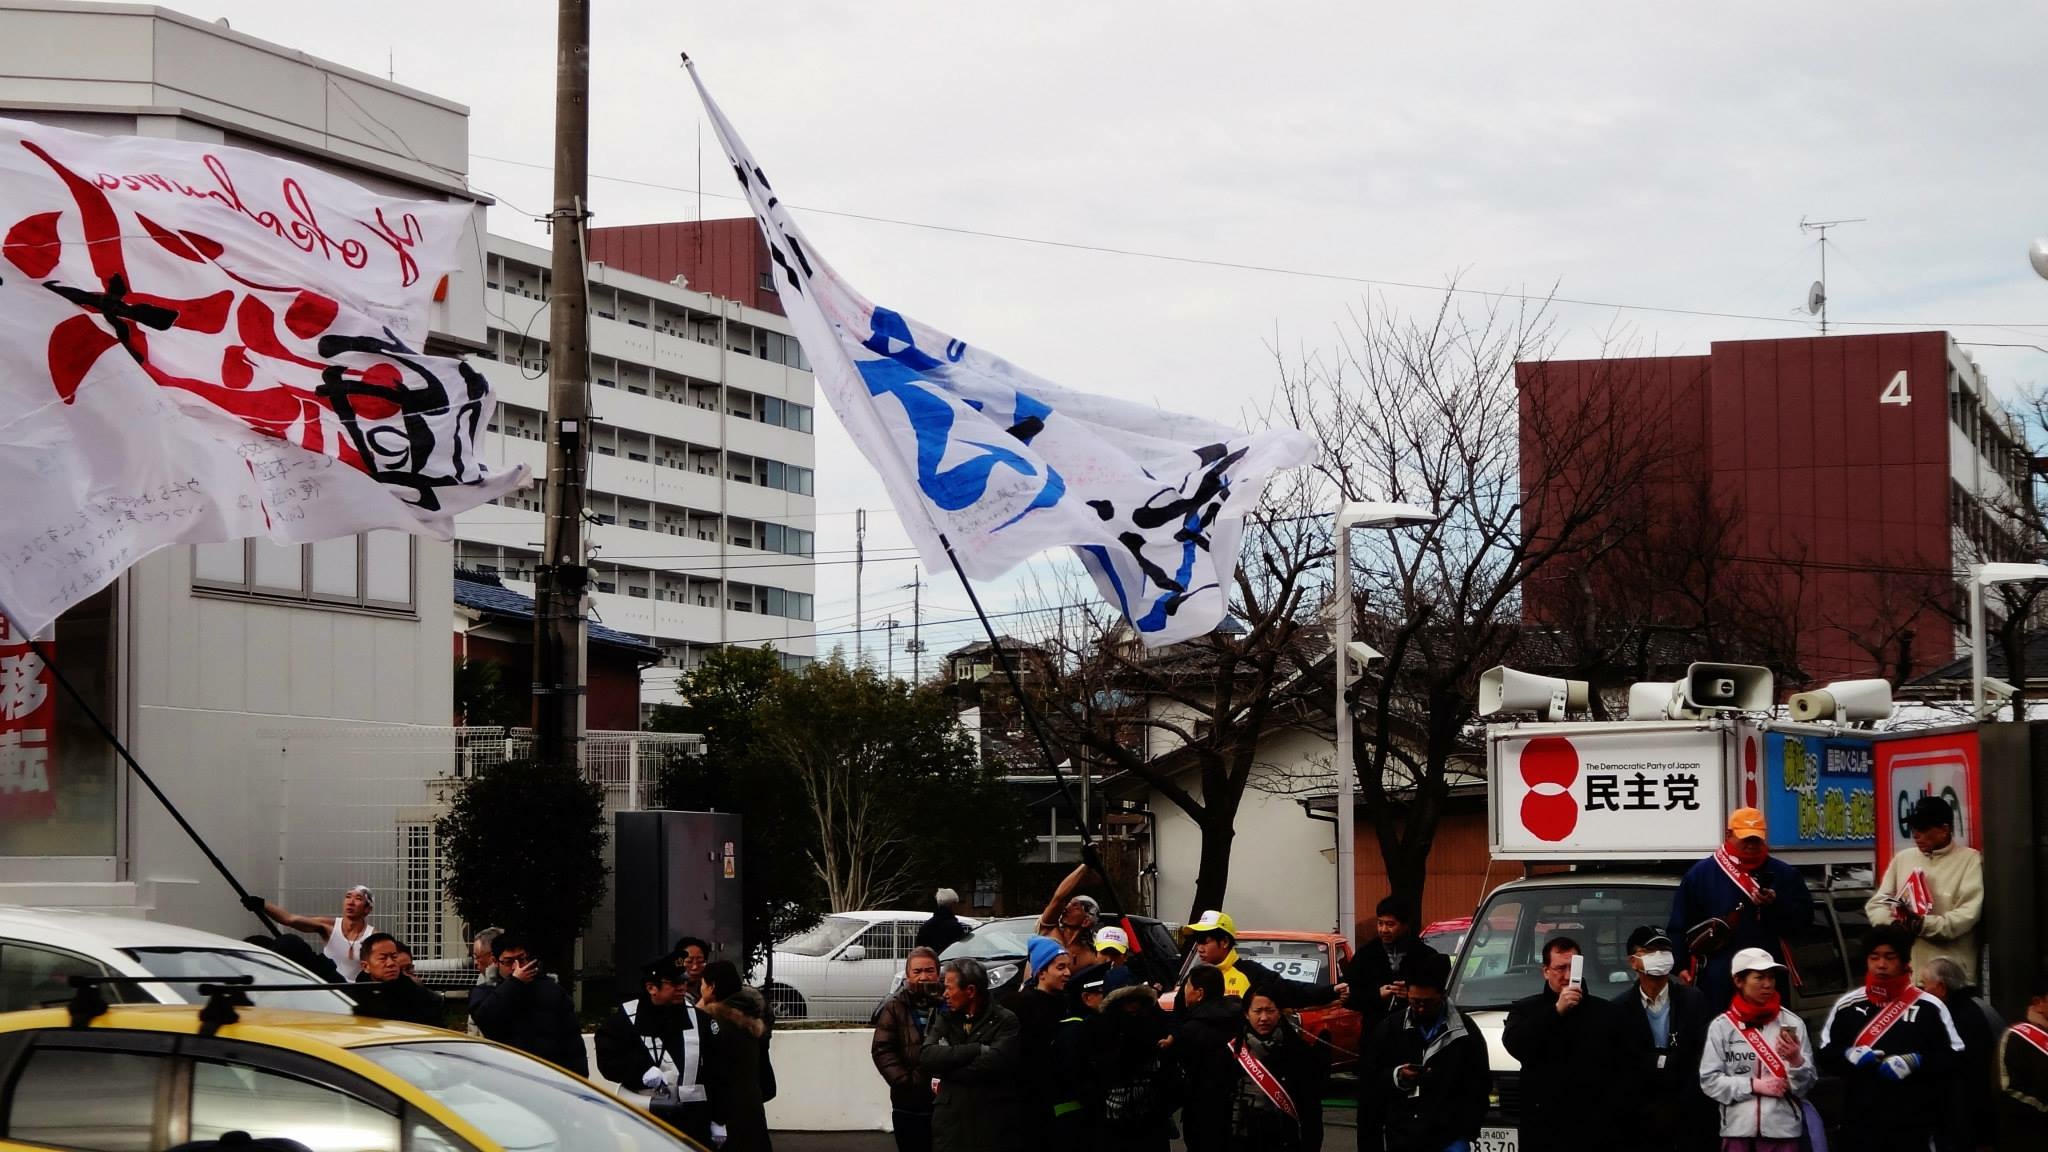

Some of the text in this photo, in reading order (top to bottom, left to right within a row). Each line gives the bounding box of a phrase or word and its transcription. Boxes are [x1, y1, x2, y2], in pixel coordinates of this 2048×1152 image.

[1879, 369, 1912, 407] 4
[0, 651, 49, 792] 移転
[1586, 761, 1700, 771] The Democratic Party of Japan
[1584, 771, 1700, 811] 民主党
[1272, 961, 1303, 976] 95
[1879, 1000, 1907, 1028] TOYOTA
[1244, 1054, 1265, 1081] TOYOTA
[1724, 1050, 1757, 1062] Move
[1756, 1040, 1781, 1071] TOYOTA
